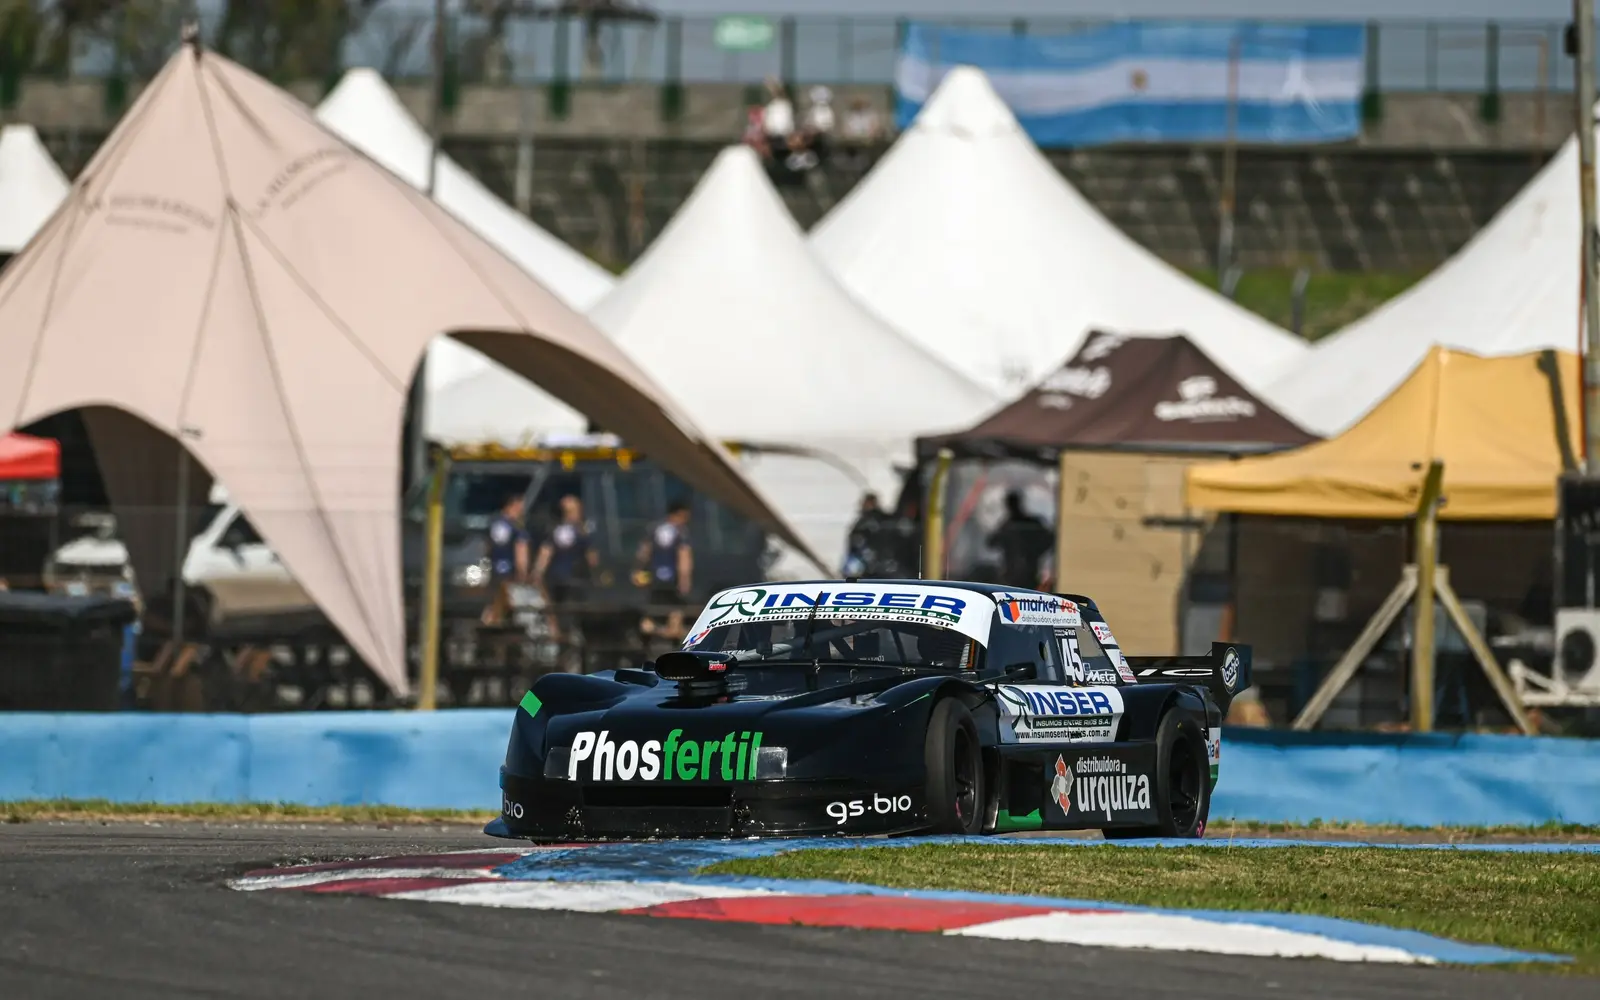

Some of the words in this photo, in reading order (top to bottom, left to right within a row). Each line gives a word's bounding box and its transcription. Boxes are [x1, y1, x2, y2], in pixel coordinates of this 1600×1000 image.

[764, 592, 966, 615] INSER
[768, 606, 834, 614] INSUMOS
[888, 607, 923, 615] RIOS
[926, 612, 955, 622] S.A.
[1062, 638, 1085, 683] 45
[1085, 669, 1117, 682] Meta
[1026, 691, 1114, 715] INSER
[1035, 719, 1063, 728] INSUMOS
[568, 729, 763, 781] Phosfertil
[1076, 756, 1121, 774] distribuidora
[1076, 763, 1151, 821] urquiza
